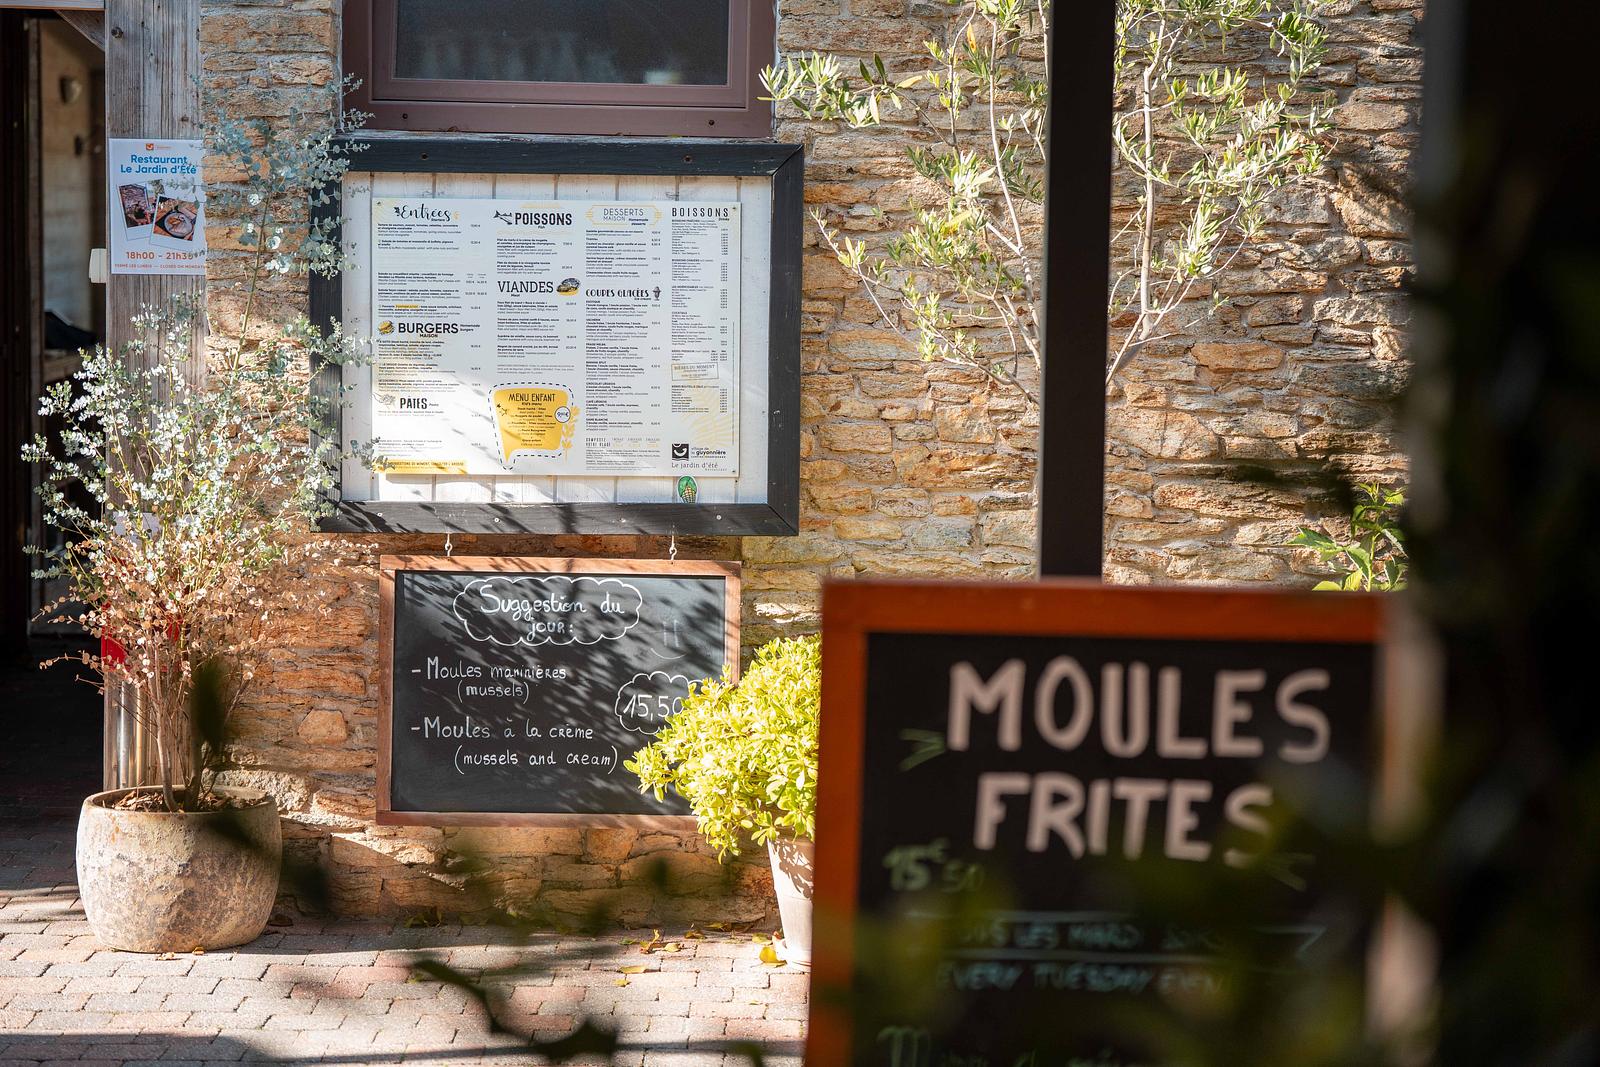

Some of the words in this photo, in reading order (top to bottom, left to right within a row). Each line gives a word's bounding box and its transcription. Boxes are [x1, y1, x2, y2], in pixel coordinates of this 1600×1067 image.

[131, 154, 188, 164] Restaurant
[120, 165, 132, 173] Le
[135, 165, 167, 174] Jardin
[400, 203, 451, 222] Entrées
[603, 208, 644, 216] DESSERTS
[671, 207, 729, 217] BOISSONS
[514, 212, 573, 226] POISSONS
[126, 251, 155, 259] 18h00
[497, 280, 554, 293] VIANDES
[585, 288, 615, 297] COUPES
[617, 287, 649, 298] GLACÉES
[398, 322, 459, 334] BURGERS
[400, 395, 428, 409] PÂTES
[508, 392, 529, 402] MENU
[531, 393, 556, 402] ENFANT
[680, 461, 699, 469] jardin
[479, 584, 587, 621] Suggestion
[599, 591, 625, 614] du
[457, 680, 530, 705] (mussels)
[946, 654, 1332, 764] MOULES
[503, 716, 516, 738] à
[525, 718, 542, 738] la
[454, 744, 519, 775] (mussels
[528, 749, 557, 765] and
[973, 771, 1274, 869] FRITES
